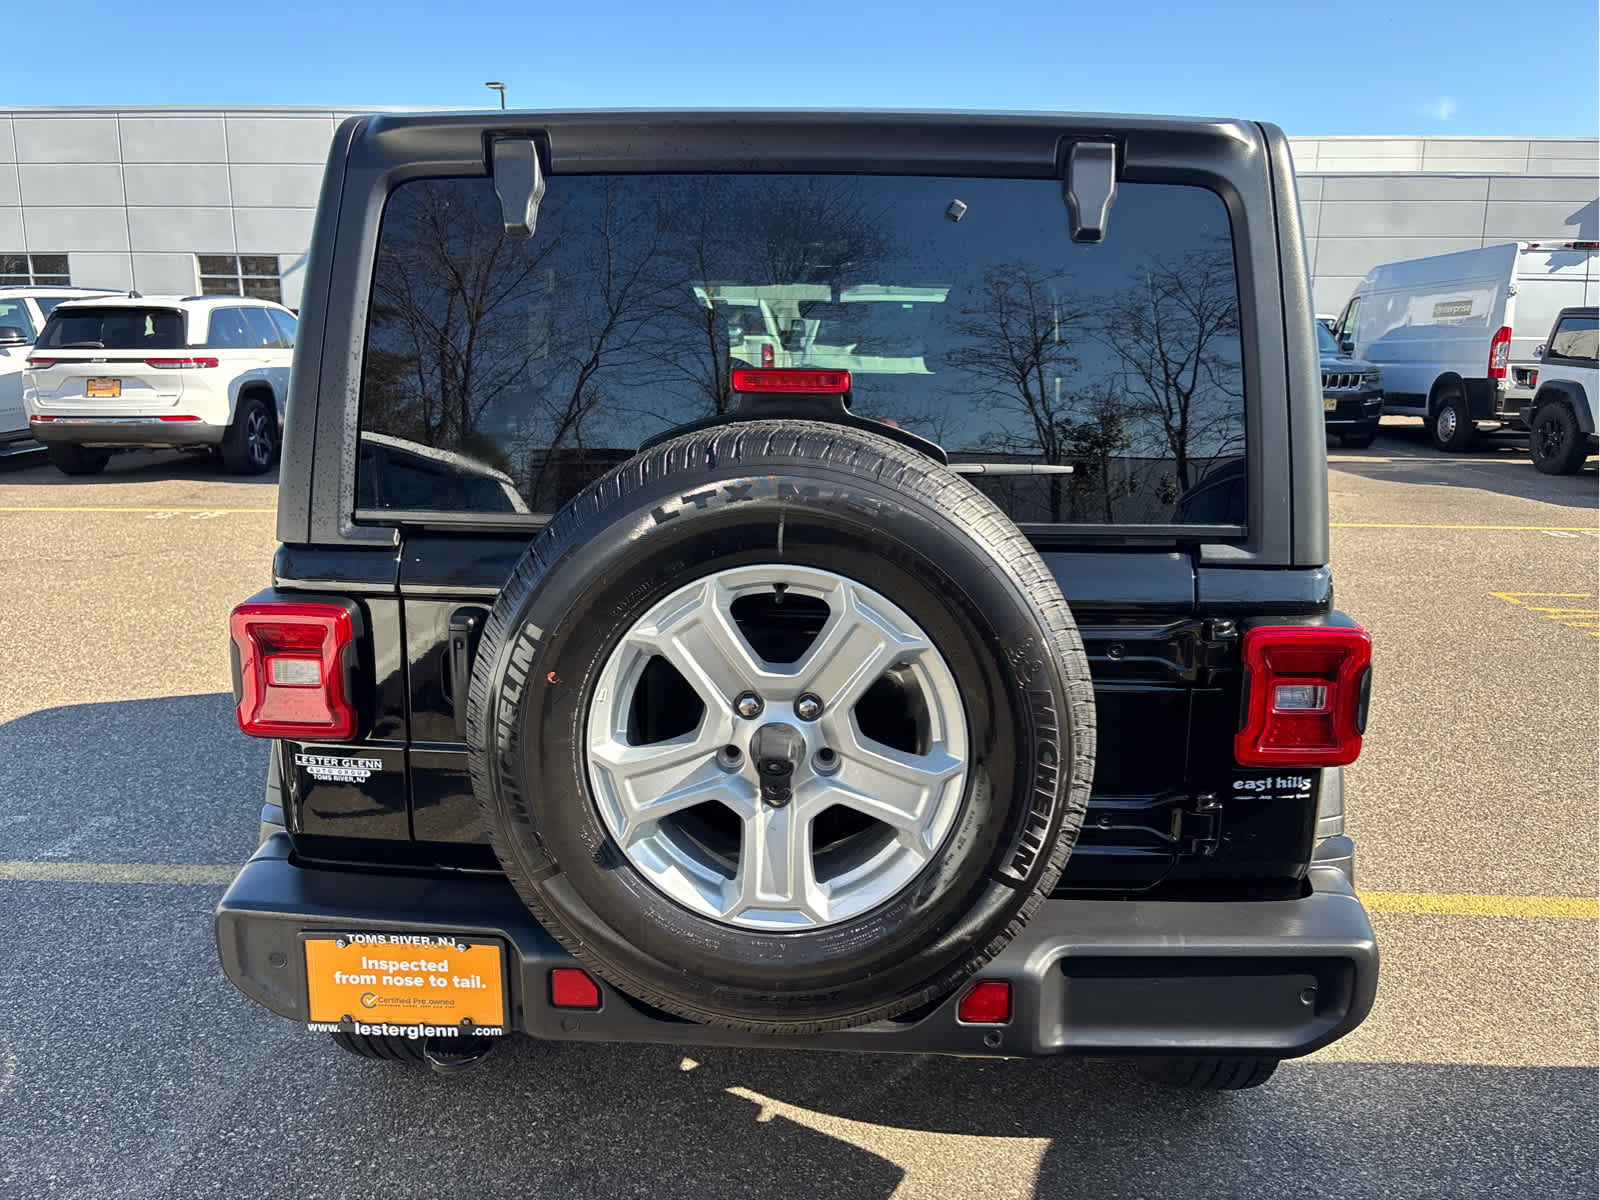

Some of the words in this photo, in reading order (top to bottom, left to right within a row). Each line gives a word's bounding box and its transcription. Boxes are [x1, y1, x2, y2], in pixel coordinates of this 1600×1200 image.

[295, 755, 338, 767] LESTER
[341, 758, 382, 769] GLENN
[313, 773, 333, 781] TOMS
[1011, 690, 1060, 879] MICHELIN
[1232, 777, 1272, 792] east
[1275, 776, 1312, 791] hills
[346, 934, 386, 944] TOMS
[438, 936, 456, 946] NJ
[361, 956, 449, 974] Inspected
[333, 970, 377, 985] from
[382, 975, 425, 987] nose
[429, 974, 448, 988] to
[452, 974, 487, 989] tail.
[307, 1022, 341, 1033] www.
[354, 1021, 459, 1040] lesterglenn
[472, 1026, 503, 1037] .com
